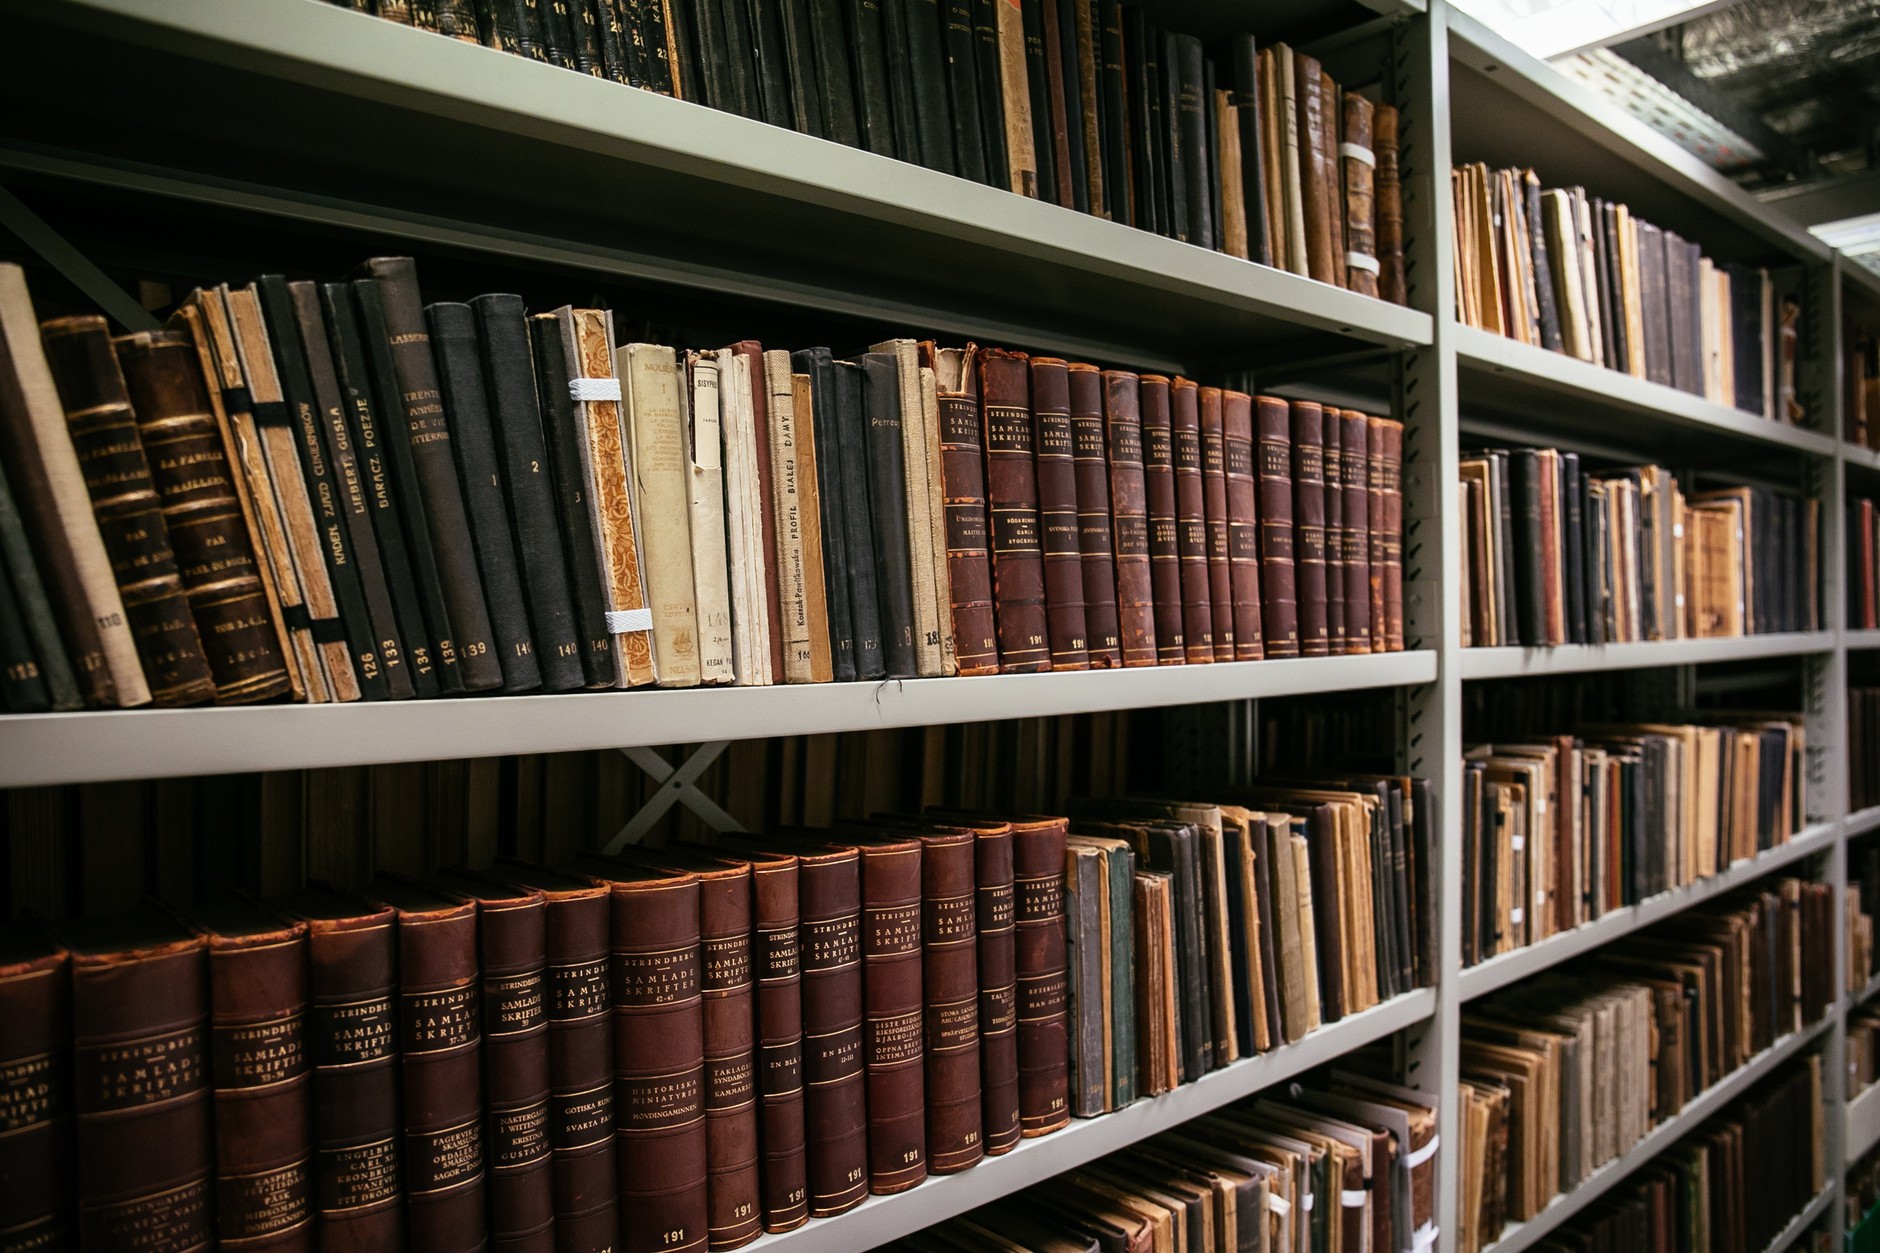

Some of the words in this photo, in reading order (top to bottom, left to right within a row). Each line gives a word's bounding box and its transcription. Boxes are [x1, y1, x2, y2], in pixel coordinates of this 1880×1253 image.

[356, 398, 376, 448] POEZJE
[782, 416, 793, 447] DAMY
[532, 460, 539, 473] 2
[318, 482, 336, 518] ZJAZD
[575, 492, 581, 503] 3
[591, 639, 609, 652] 140
[1029, 635, 1042, 646] 191
[1072, 638, 1084, 649] 191
[382, 640, 400, 668] 133
[440, 640, 456, 666] 139
[558, 642, 577, 658] 140
[360, 652, 379, 680] 126
[414, 647, 432, 674] 134
[706, 658, 724, 667] KEGAN
[624, 952, 695, 967] STRINDBERG
[626, 968, 696, 985] SAMLADE
[626, 978, 696, 996] SKRIFTER
[501, 994, 542, 1011] SAMLADE
[656, 994, 674, 1003] 42-43
[1029, 1001, 1046, 1009] HAN
[501, 1006, 542, 1023] SKRIFTER
[875, 1020, 899, 1030] SISTE
[822, 1049, 835, 1058] EN
[837, 1042, 852, 1055] BLÅ
[876, 1051, 905, 1061] INTIMA
[770, 1061, 782, 1069] EN
[784, 1055, 798, 1067] BLÅ
[632, 1080, 697, 1096] HISTORISKA
[632, 1088, 698, 1106] MINIATYRER
[1051, 1097, 1064, 1110] 191
[566, 1120, 598, 1134] SVARTA
[432, 1128, 473, 1148] FAGERVIK
[512, 1131, 544, 1146] KRISTINA
[964, 1132, 978, 1146] 191
[433, 1146, 475, 1165] ORDALEK
[502, 1144, 541, 1160] GUSTAV
[903, 1149, 919, 1165] 191
[847, 1167, 863, 1183] 191
[788, 1188, 805, 1205] 191
[733, 1202, 752, 1219] 191
[664, 1228, 684, 1244] 191
